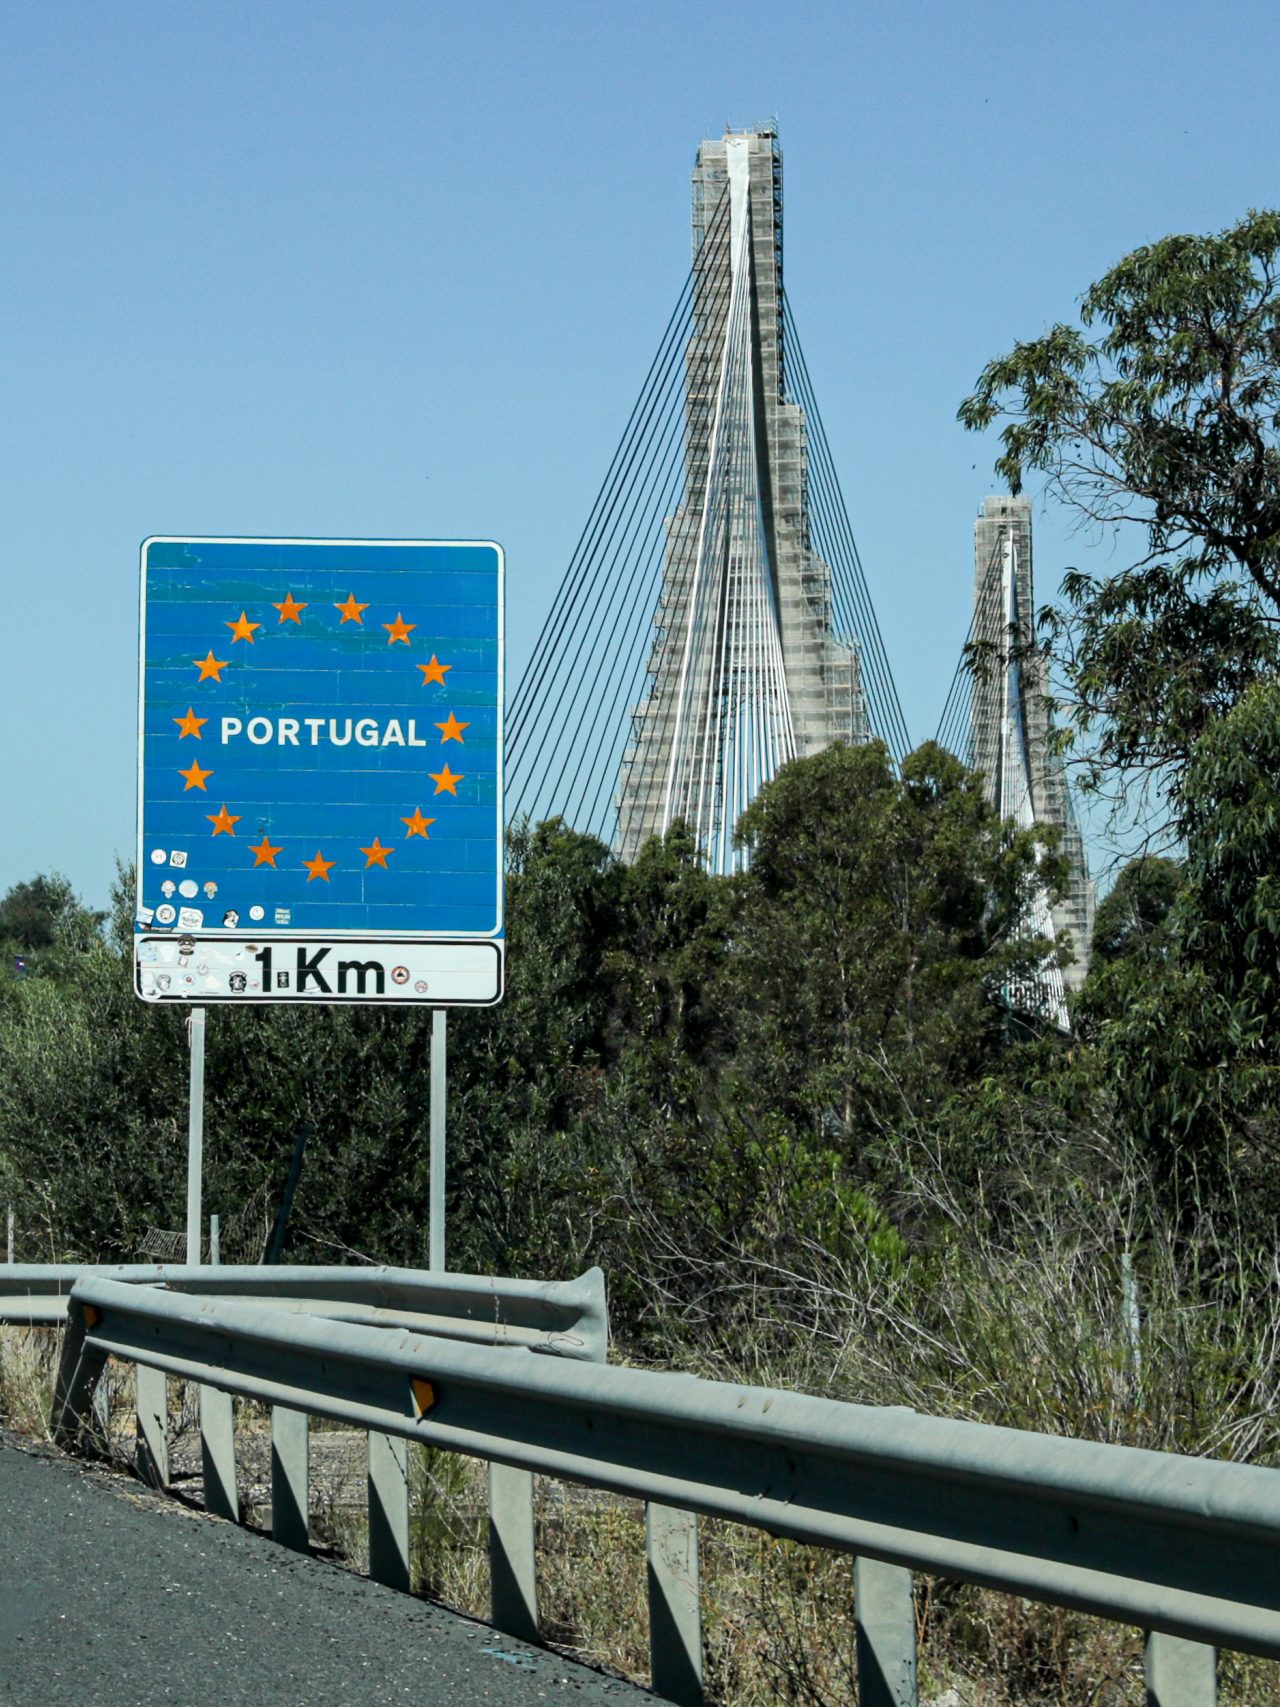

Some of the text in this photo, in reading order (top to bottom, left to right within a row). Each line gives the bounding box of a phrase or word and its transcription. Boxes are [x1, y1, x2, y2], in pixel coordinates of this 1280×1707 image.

[221, 716, 427, 747] PORTUGAL
[255, 946, 385, 994] 1 Km
